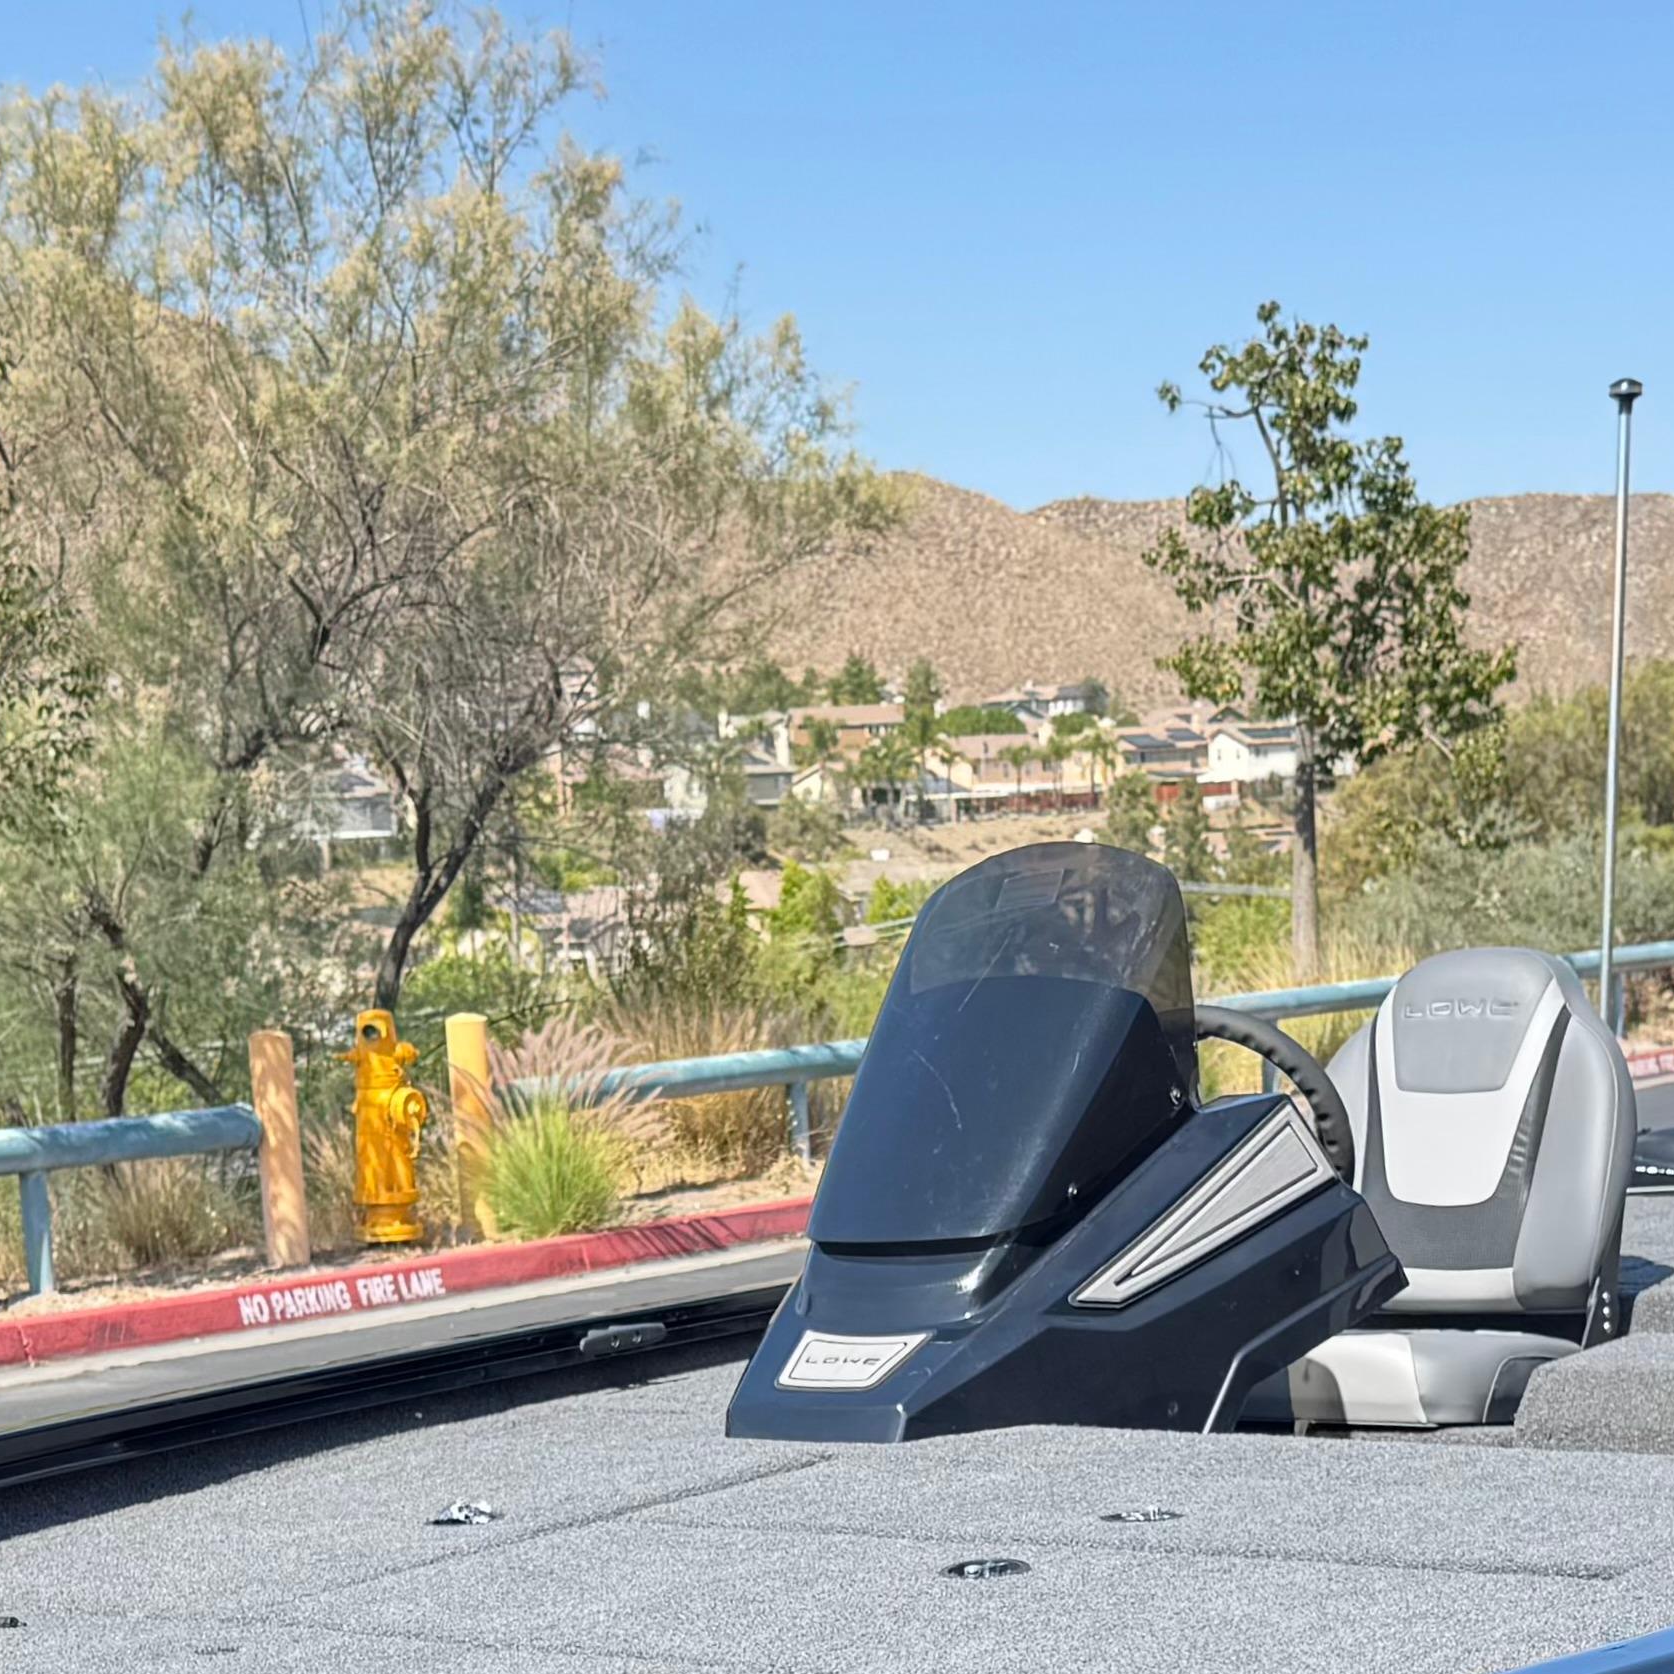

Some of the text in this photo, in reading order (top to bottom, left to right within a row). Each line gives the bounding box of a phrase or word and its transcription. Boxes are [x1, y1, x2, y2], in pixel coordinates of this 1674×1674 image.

[1403, 1000, 1512, 1019] LOWE
[237, 1268, 446, 1326] NO PARKING FIRE LANE
[805, 1356, 881, 1365] LOWE
